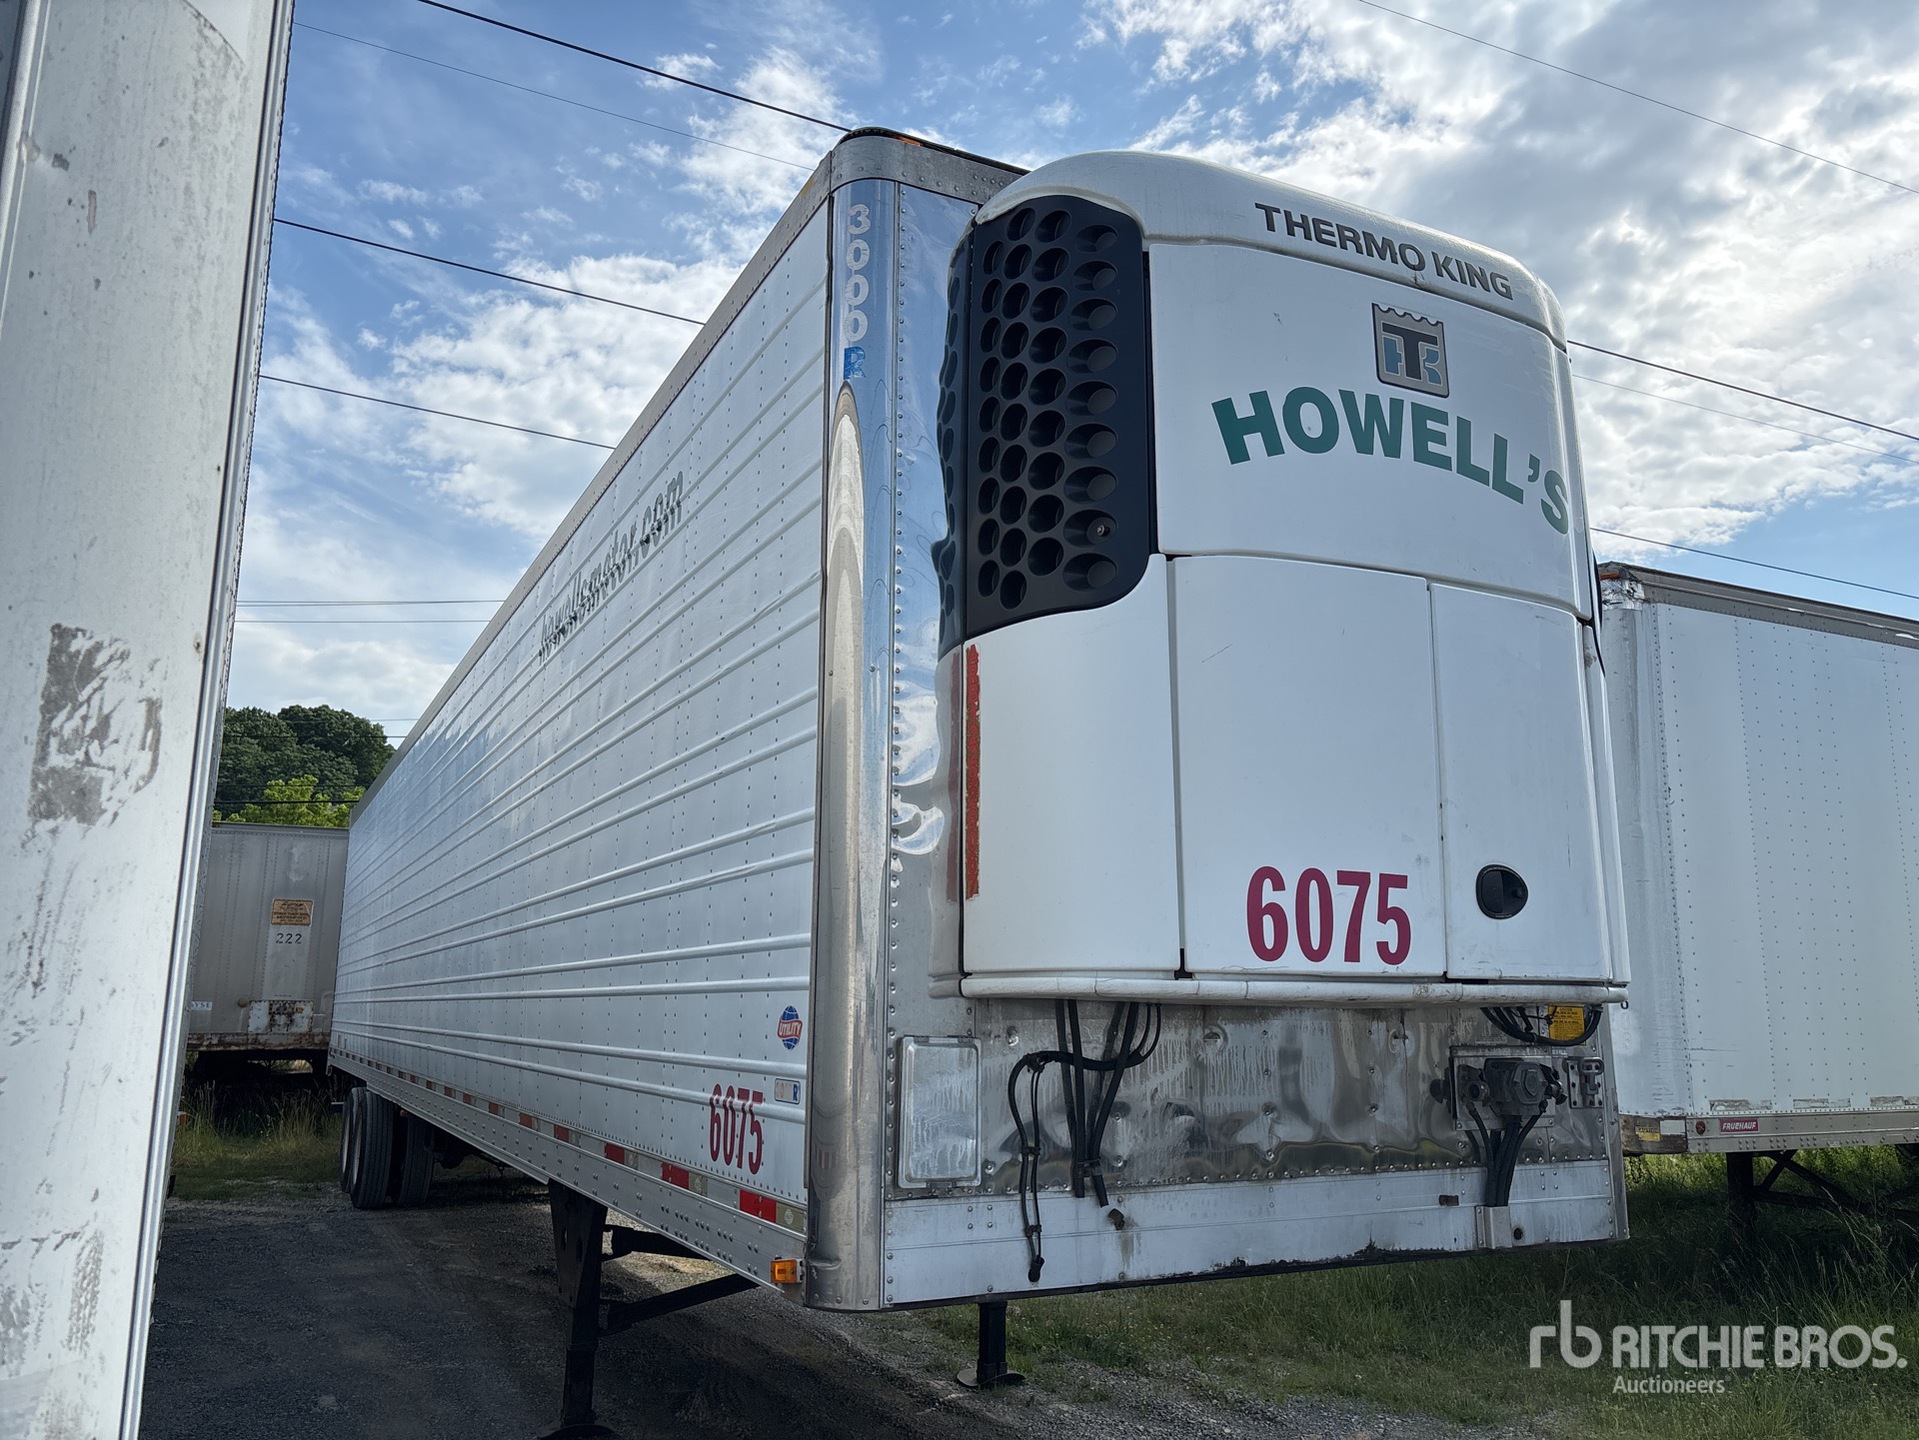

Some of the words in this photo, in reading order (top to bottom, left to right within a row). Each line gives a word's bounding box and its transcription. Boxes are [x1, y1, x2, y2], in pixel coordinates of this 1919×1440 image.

[1254, 203, 1425, 271] THERMO
[1431, 251, 1514, 300] KING
[1211, 386, 1569, 535] HOWELL'S
[275, 933, 302, 945] 222
[1247, 866, 1411, 965] 6075
[779, 1022, 801, 1036] UTILITY
[709, 1083, 764, 1175] 6075
